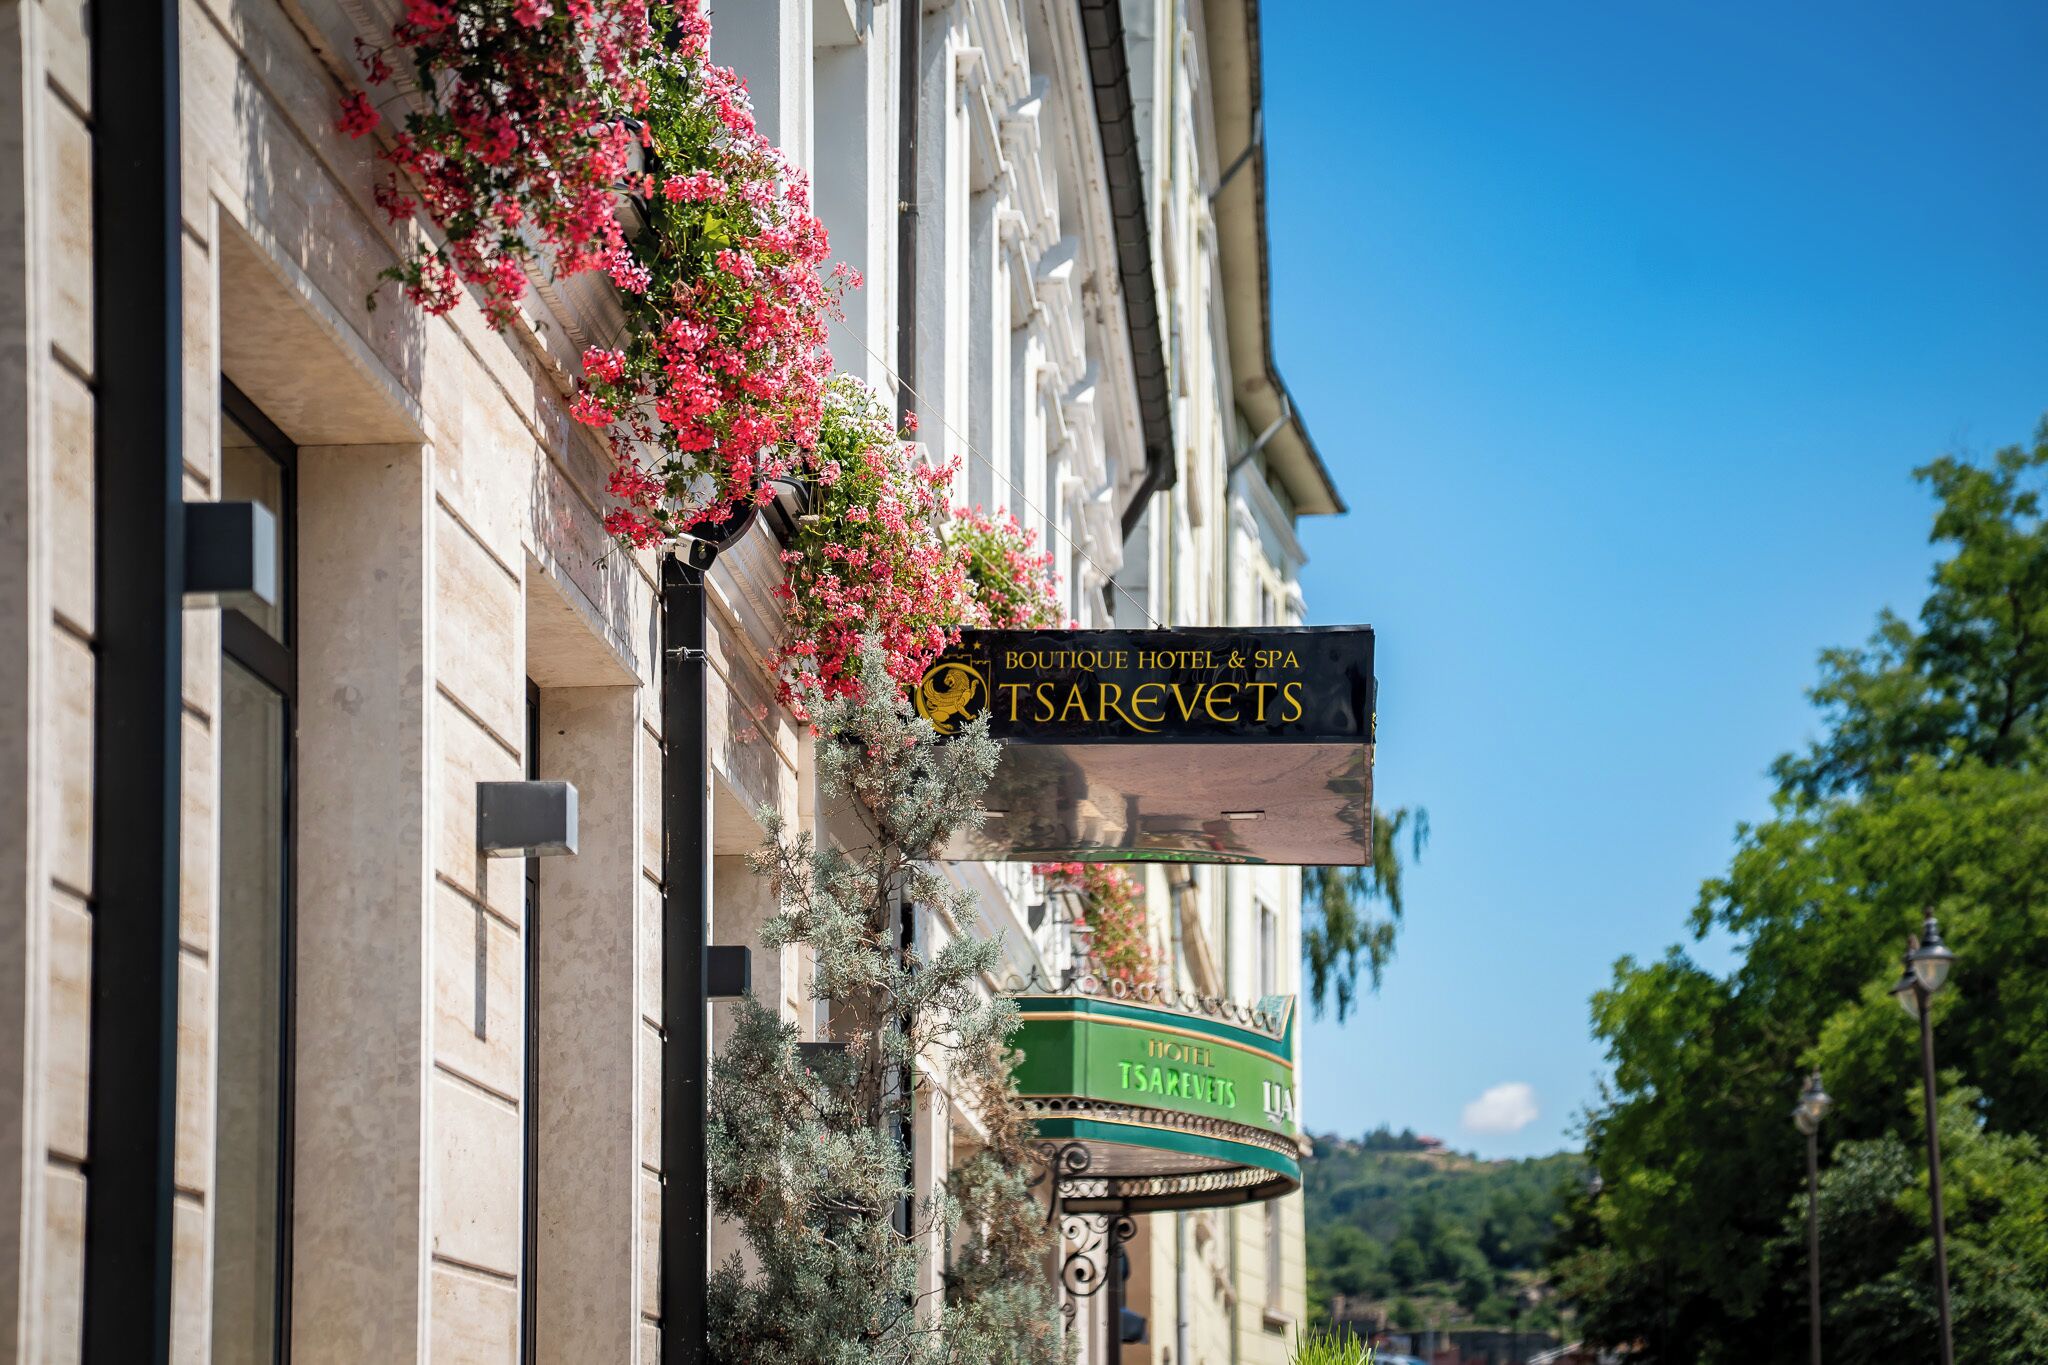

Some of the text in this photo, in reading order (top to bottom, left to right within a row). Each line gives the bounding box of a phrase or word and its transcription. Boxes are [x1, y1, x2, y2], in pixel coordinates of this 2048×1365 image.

[1005, 649, 1300, 672] BOUTIQUE HOTEL & SPA
[999, 681, 1303, 733] TSAREVETS
[1148, 1039, 1215, 1068] HOTEL
[1118, 1060, 1237, 1109] TSAREVETS
